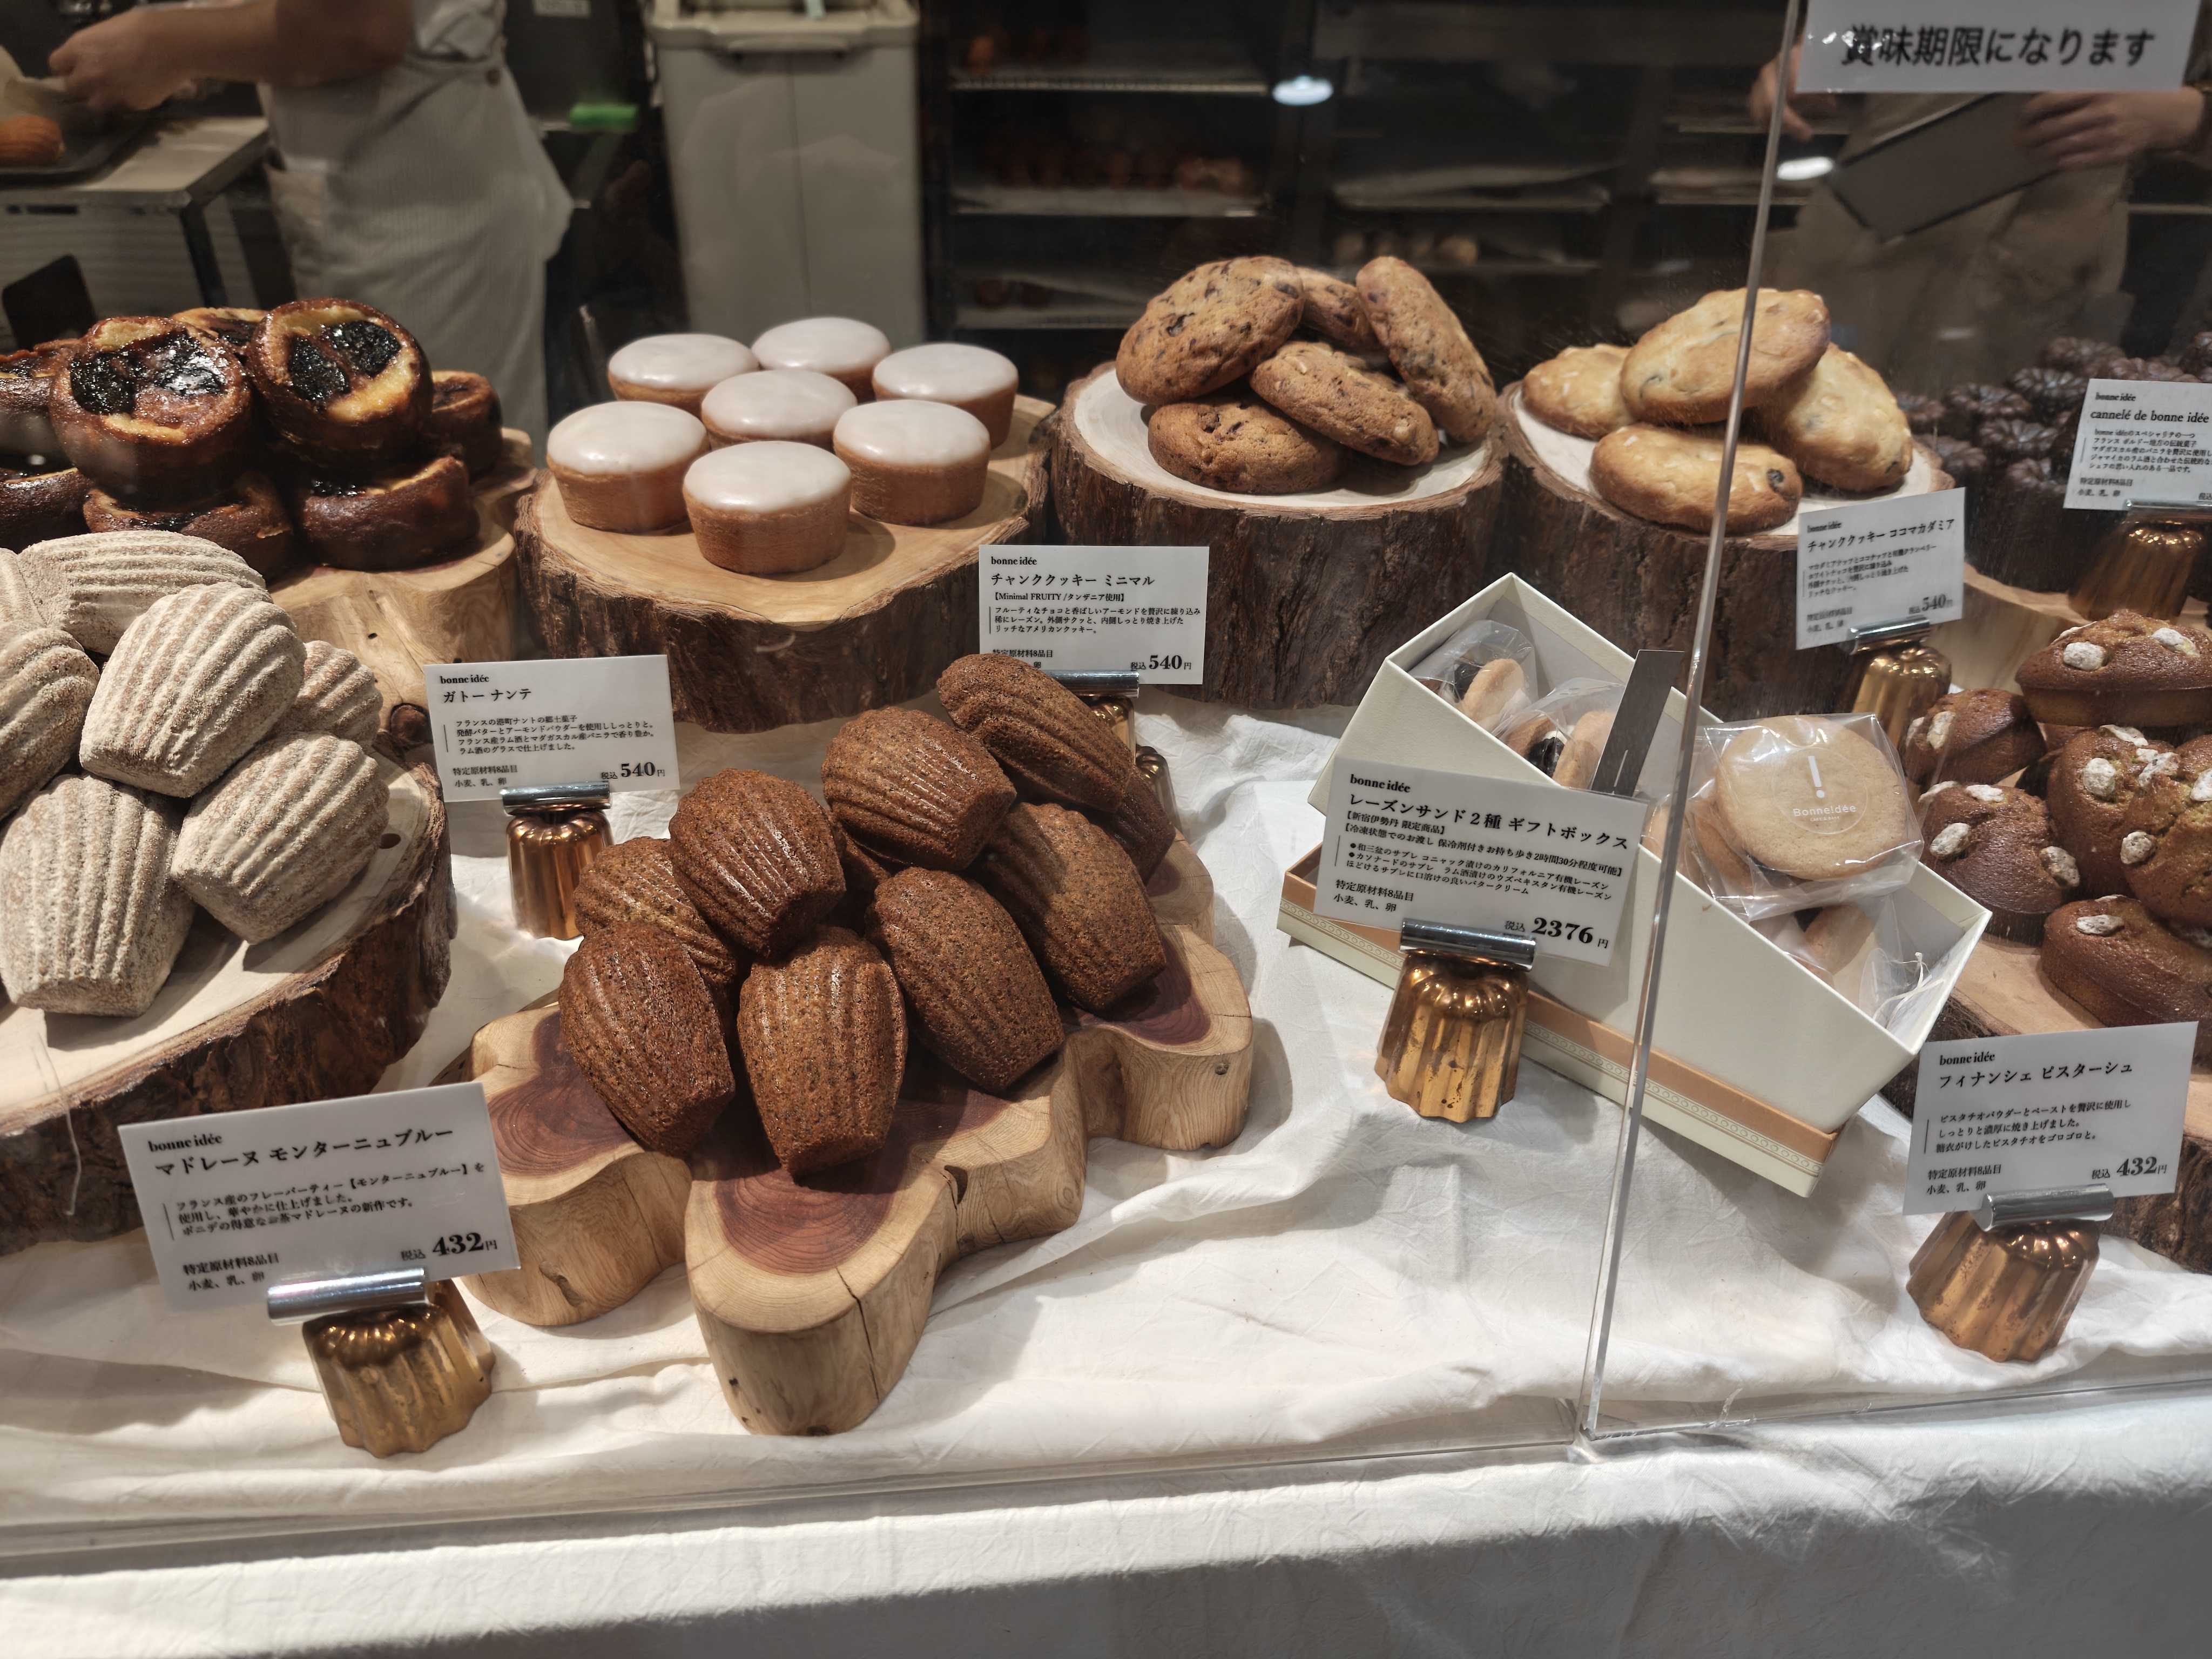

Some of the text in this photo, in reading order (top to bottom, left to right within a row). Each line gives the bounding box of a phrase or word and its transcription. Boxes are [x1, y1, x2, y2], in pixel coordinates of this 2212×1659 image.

[1842, 25, 2154, 66] 賞味期限になります
[2090, 410, 2209, 423] cannelé de bonne idée
[991, 556, 1037, 565] bonne idée
[992, 574, 1154, 586] チャンククッキー ミニマル
[997, 625, 1096, 633] リッチなアメリカンクッキー。
[471, 675, 489, 683] idée
[444, 689, 531, 703] ガトー ナンテ
[1350, 774, 1410, 792] bonne idée
[1508, 818, 1627, 849] ギフトボックス
[1336, 880, 1413, 901] 特定原材料8品目
[1505, 921, 1525, 932] 税込
[1940, 1051, 1994, 1065] bonne idée
[1940, 1062, 2132, 1088] フィナンシェ ピスターシュ
[148, 1134, 221, 1152] bonne idée
[156, 1130, 453, 1175] マドレーヌ モンターニュブルー
